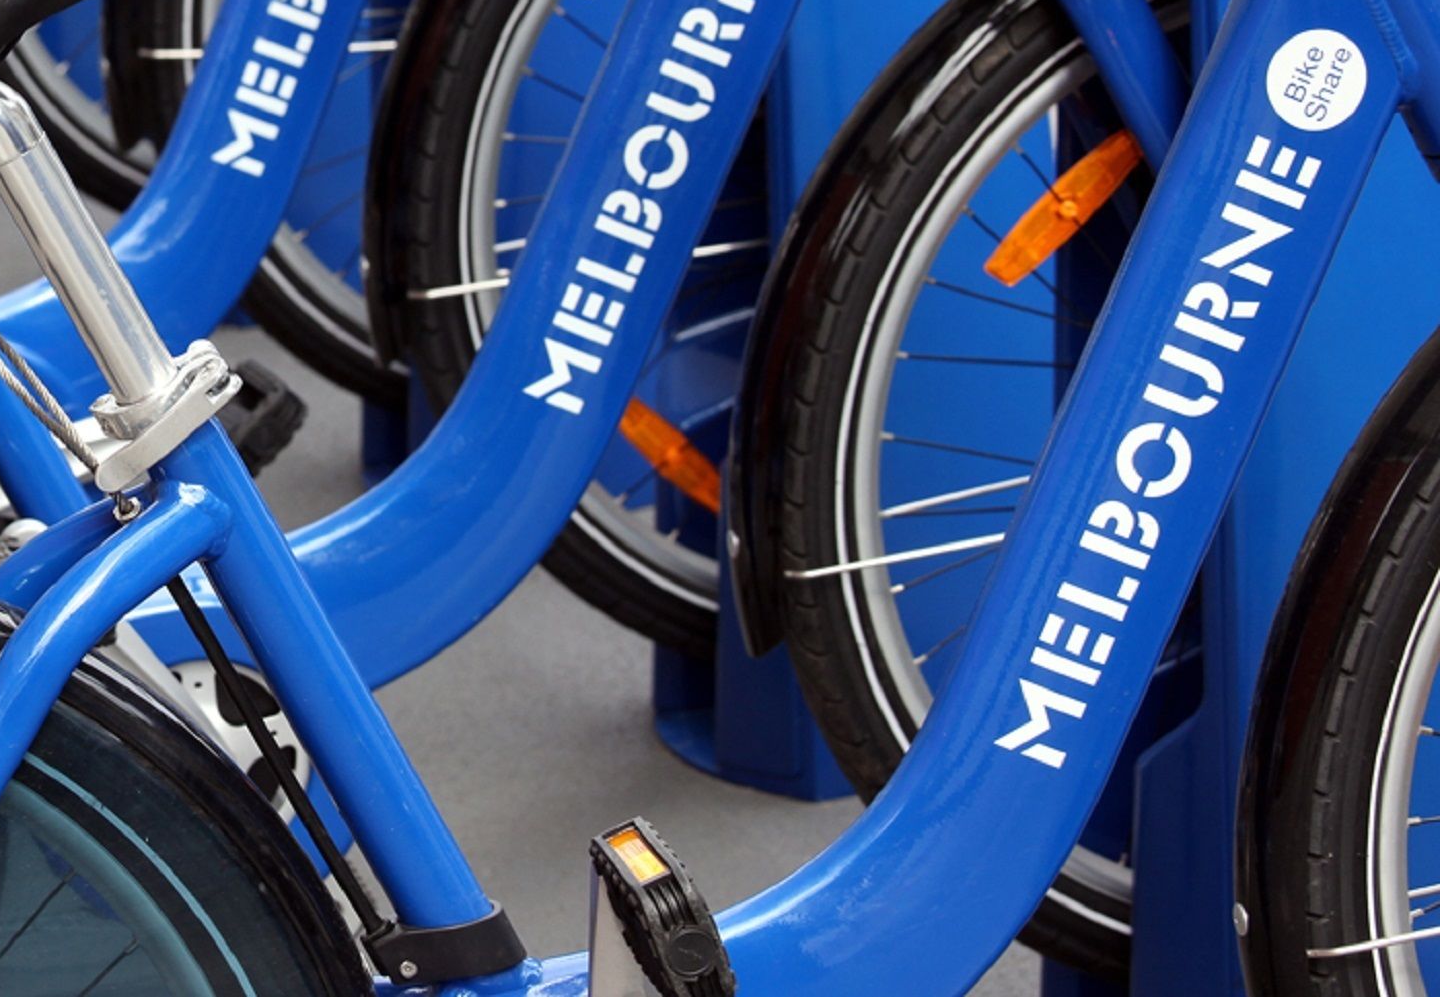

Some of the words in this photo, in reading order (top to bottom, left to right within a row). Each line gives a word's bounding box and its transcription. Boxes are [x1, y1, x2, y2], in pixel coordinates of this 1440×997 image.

[1283, 46, 1324, 103] Bike
[1304, 47, 1353, 122] Share
[993, 134, 1323, 771] MELBOURNE
